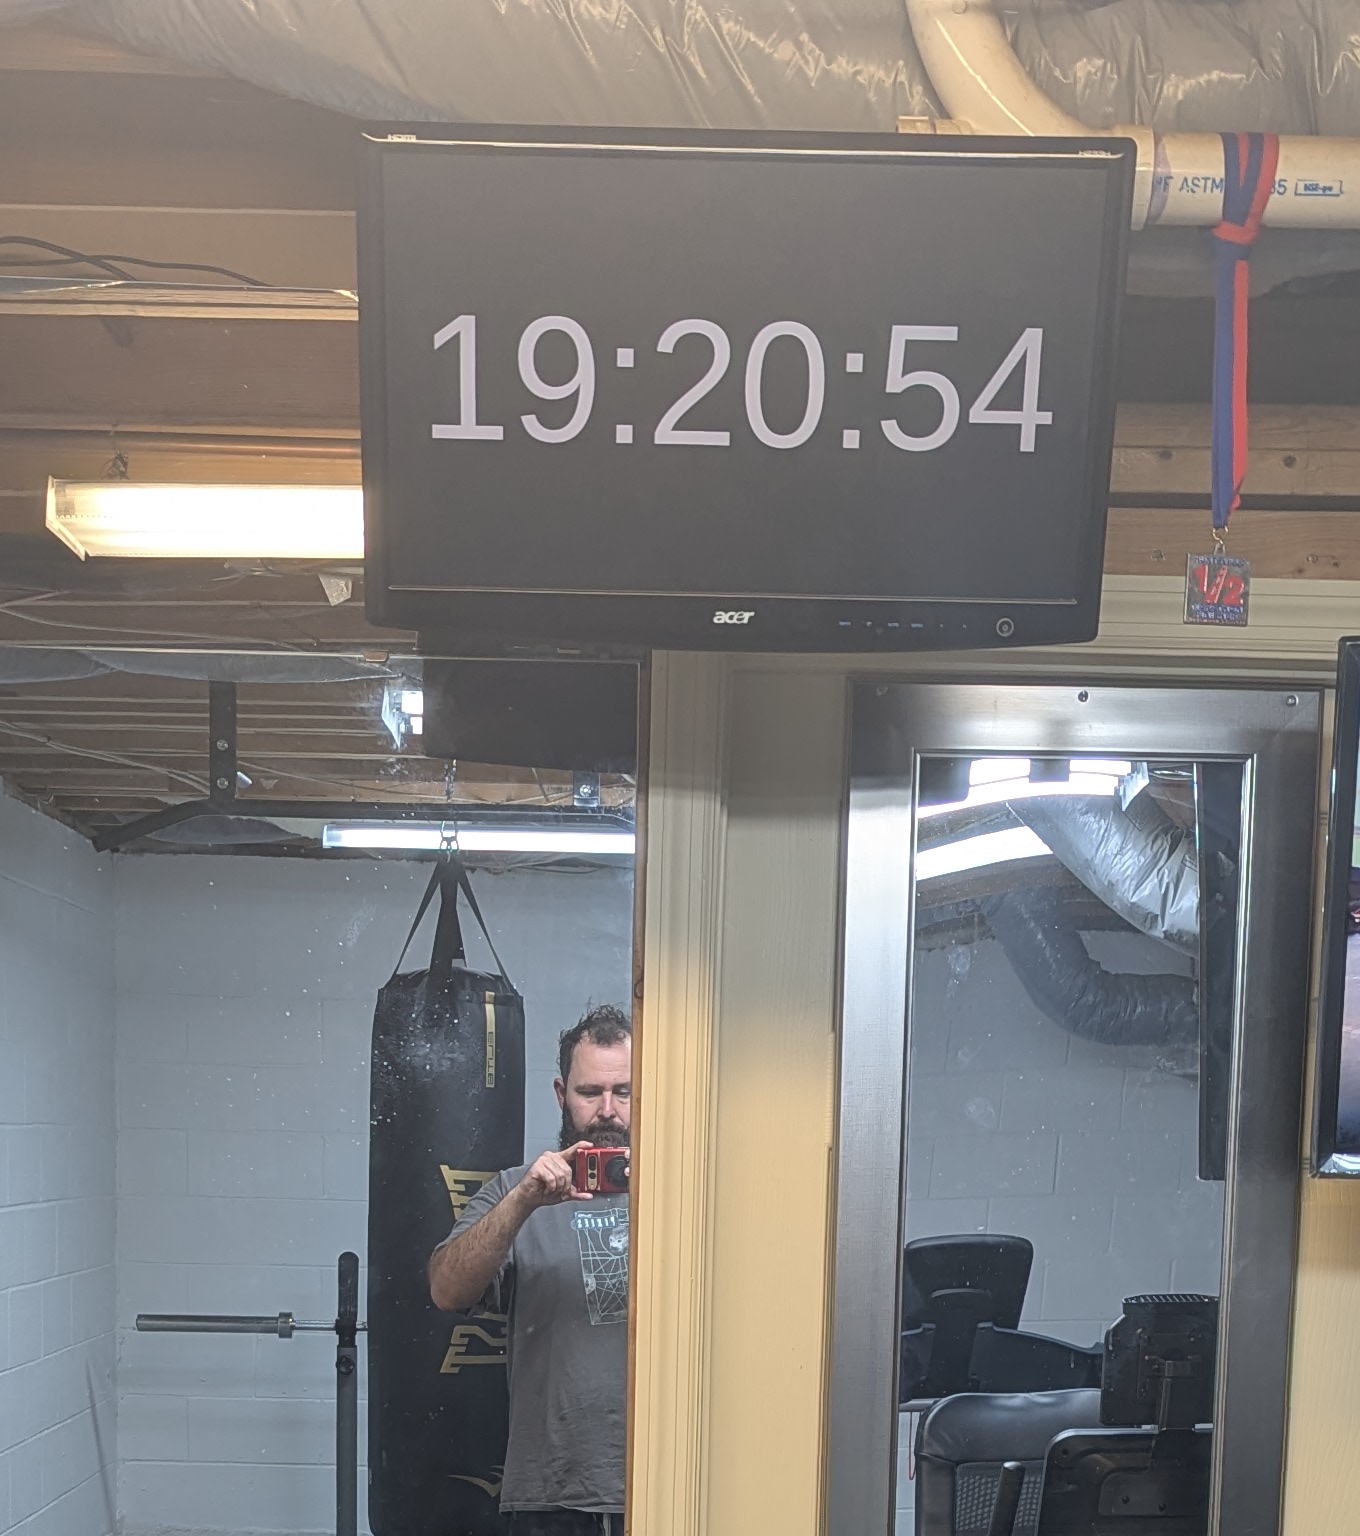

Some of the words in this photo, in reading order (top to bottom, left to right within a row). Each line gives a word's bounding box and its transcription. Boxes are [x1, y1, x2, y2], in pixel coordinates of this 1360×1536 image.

[1179, 177, 1225, 194] ASTM
[430, 314, 1053, 453] 19:20:54
[713, 611, 755, 624] acer
